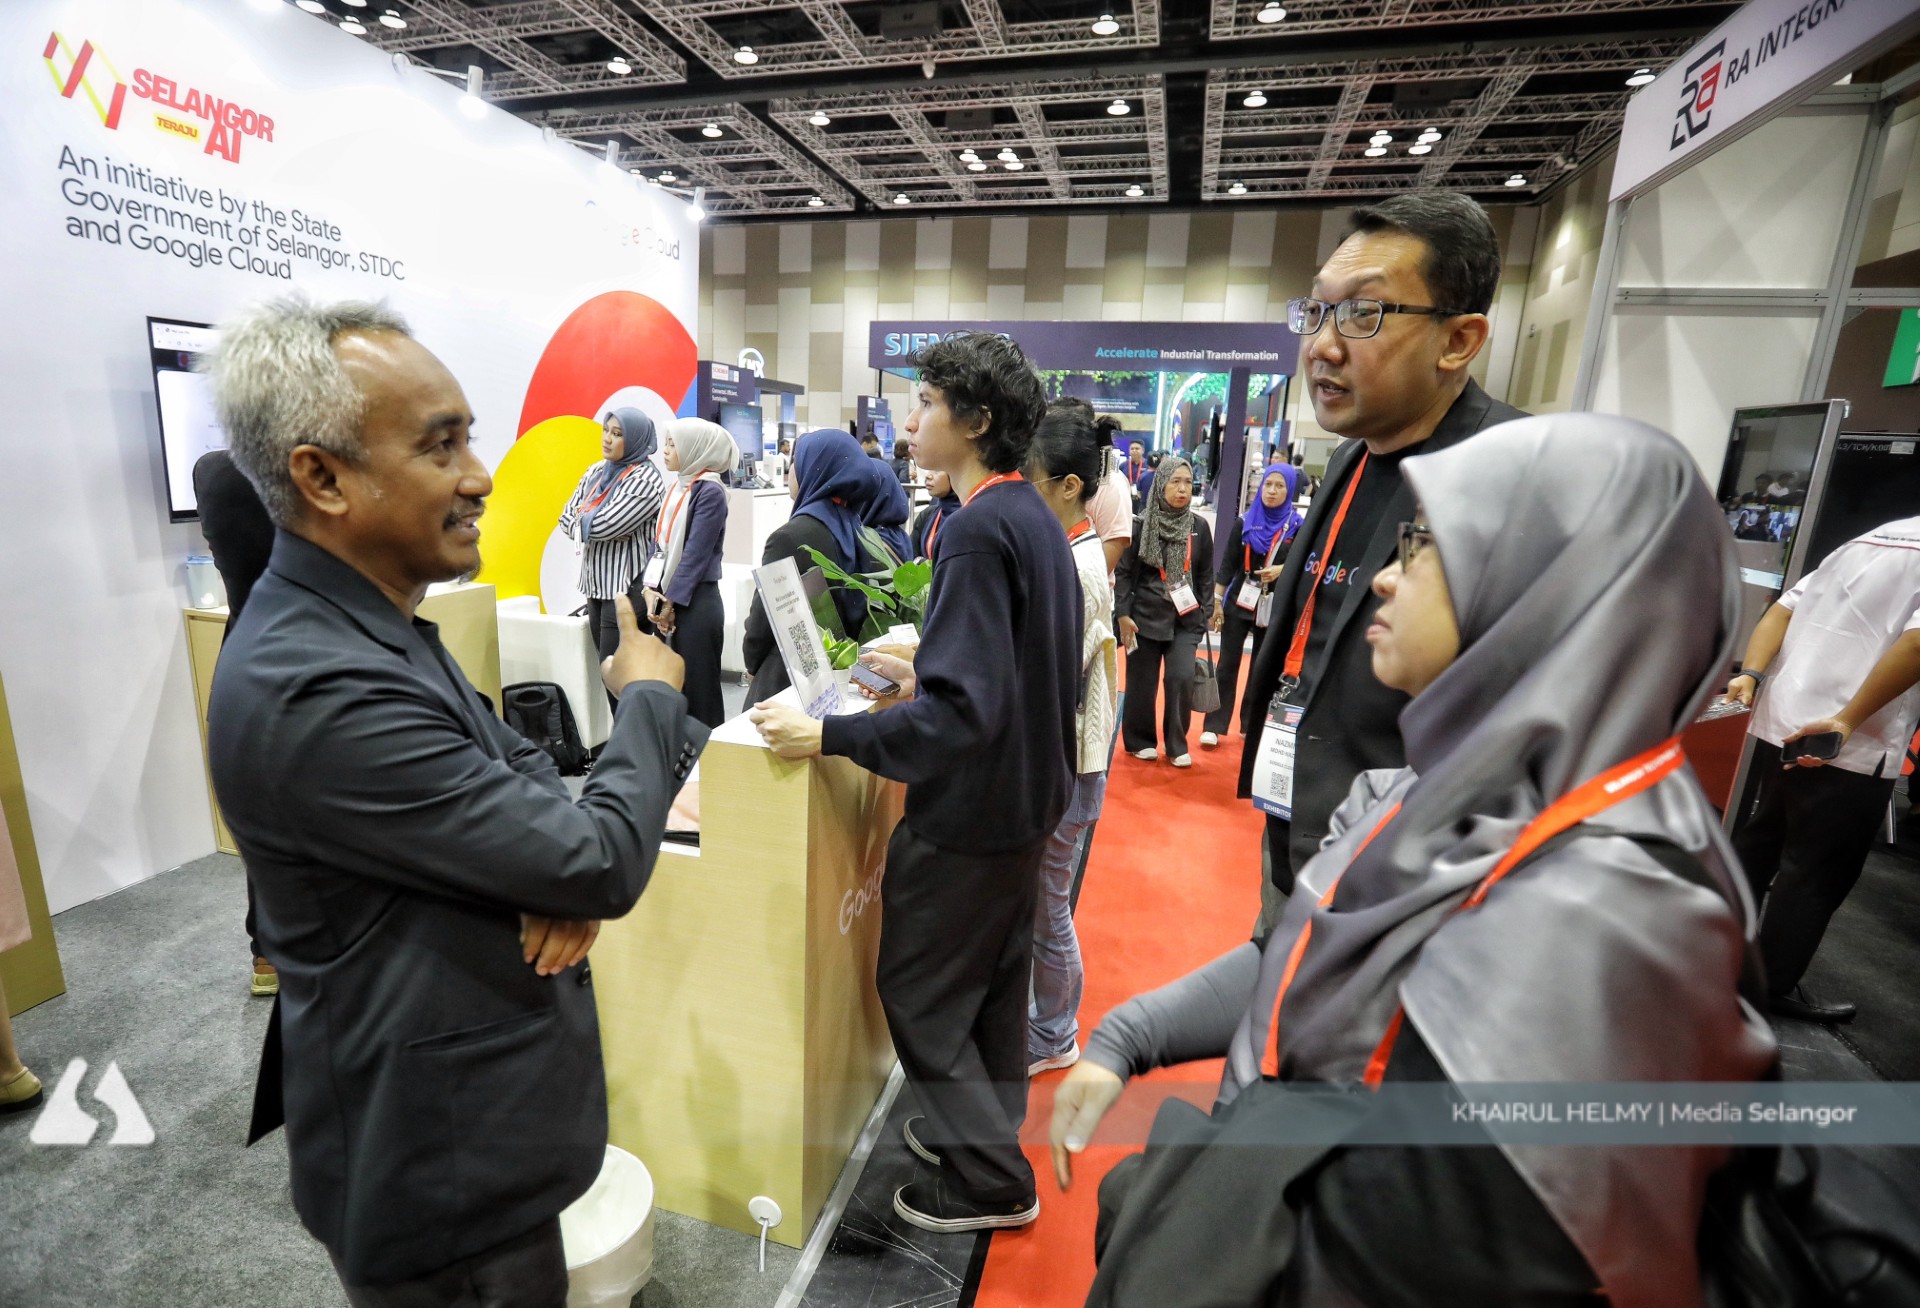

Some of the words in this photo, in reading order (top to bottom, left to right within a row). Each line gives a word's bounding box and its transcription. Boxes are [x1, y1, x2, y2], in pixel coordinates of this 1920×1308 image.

[1725, 48, 1750, 88] RA
[132, 68, 274, 142] SELANGOR
[157, 116, 198, 137] TERAJU
[204, 120, 242, 164] AI
[57, 144, 99, 179] An
[104, 156, 213, 208] initiative
[219, 188, 246, 222] by
[251, 200, 287, 227] the
[291, 209, 341, 241] State
[61, 178, 233, 242] Government
[238, 226, 261, 247] of
[266, 228, 355, 271] Selangor,
[359, 251, 405, 280] STDC
[65, 216, 122, 245] and
[128, 224, 223, 268] Google
[228, 246, 292, 279] Cloud
[1095, 347, 1159, 359] Accelerate
[1160, 349, 1205, 360] Industrial
[1206, 350, 1279, 361] Transformation
[1304, 551, 1347, 585] Gogle
[838, 844, 888, 936] Googl
